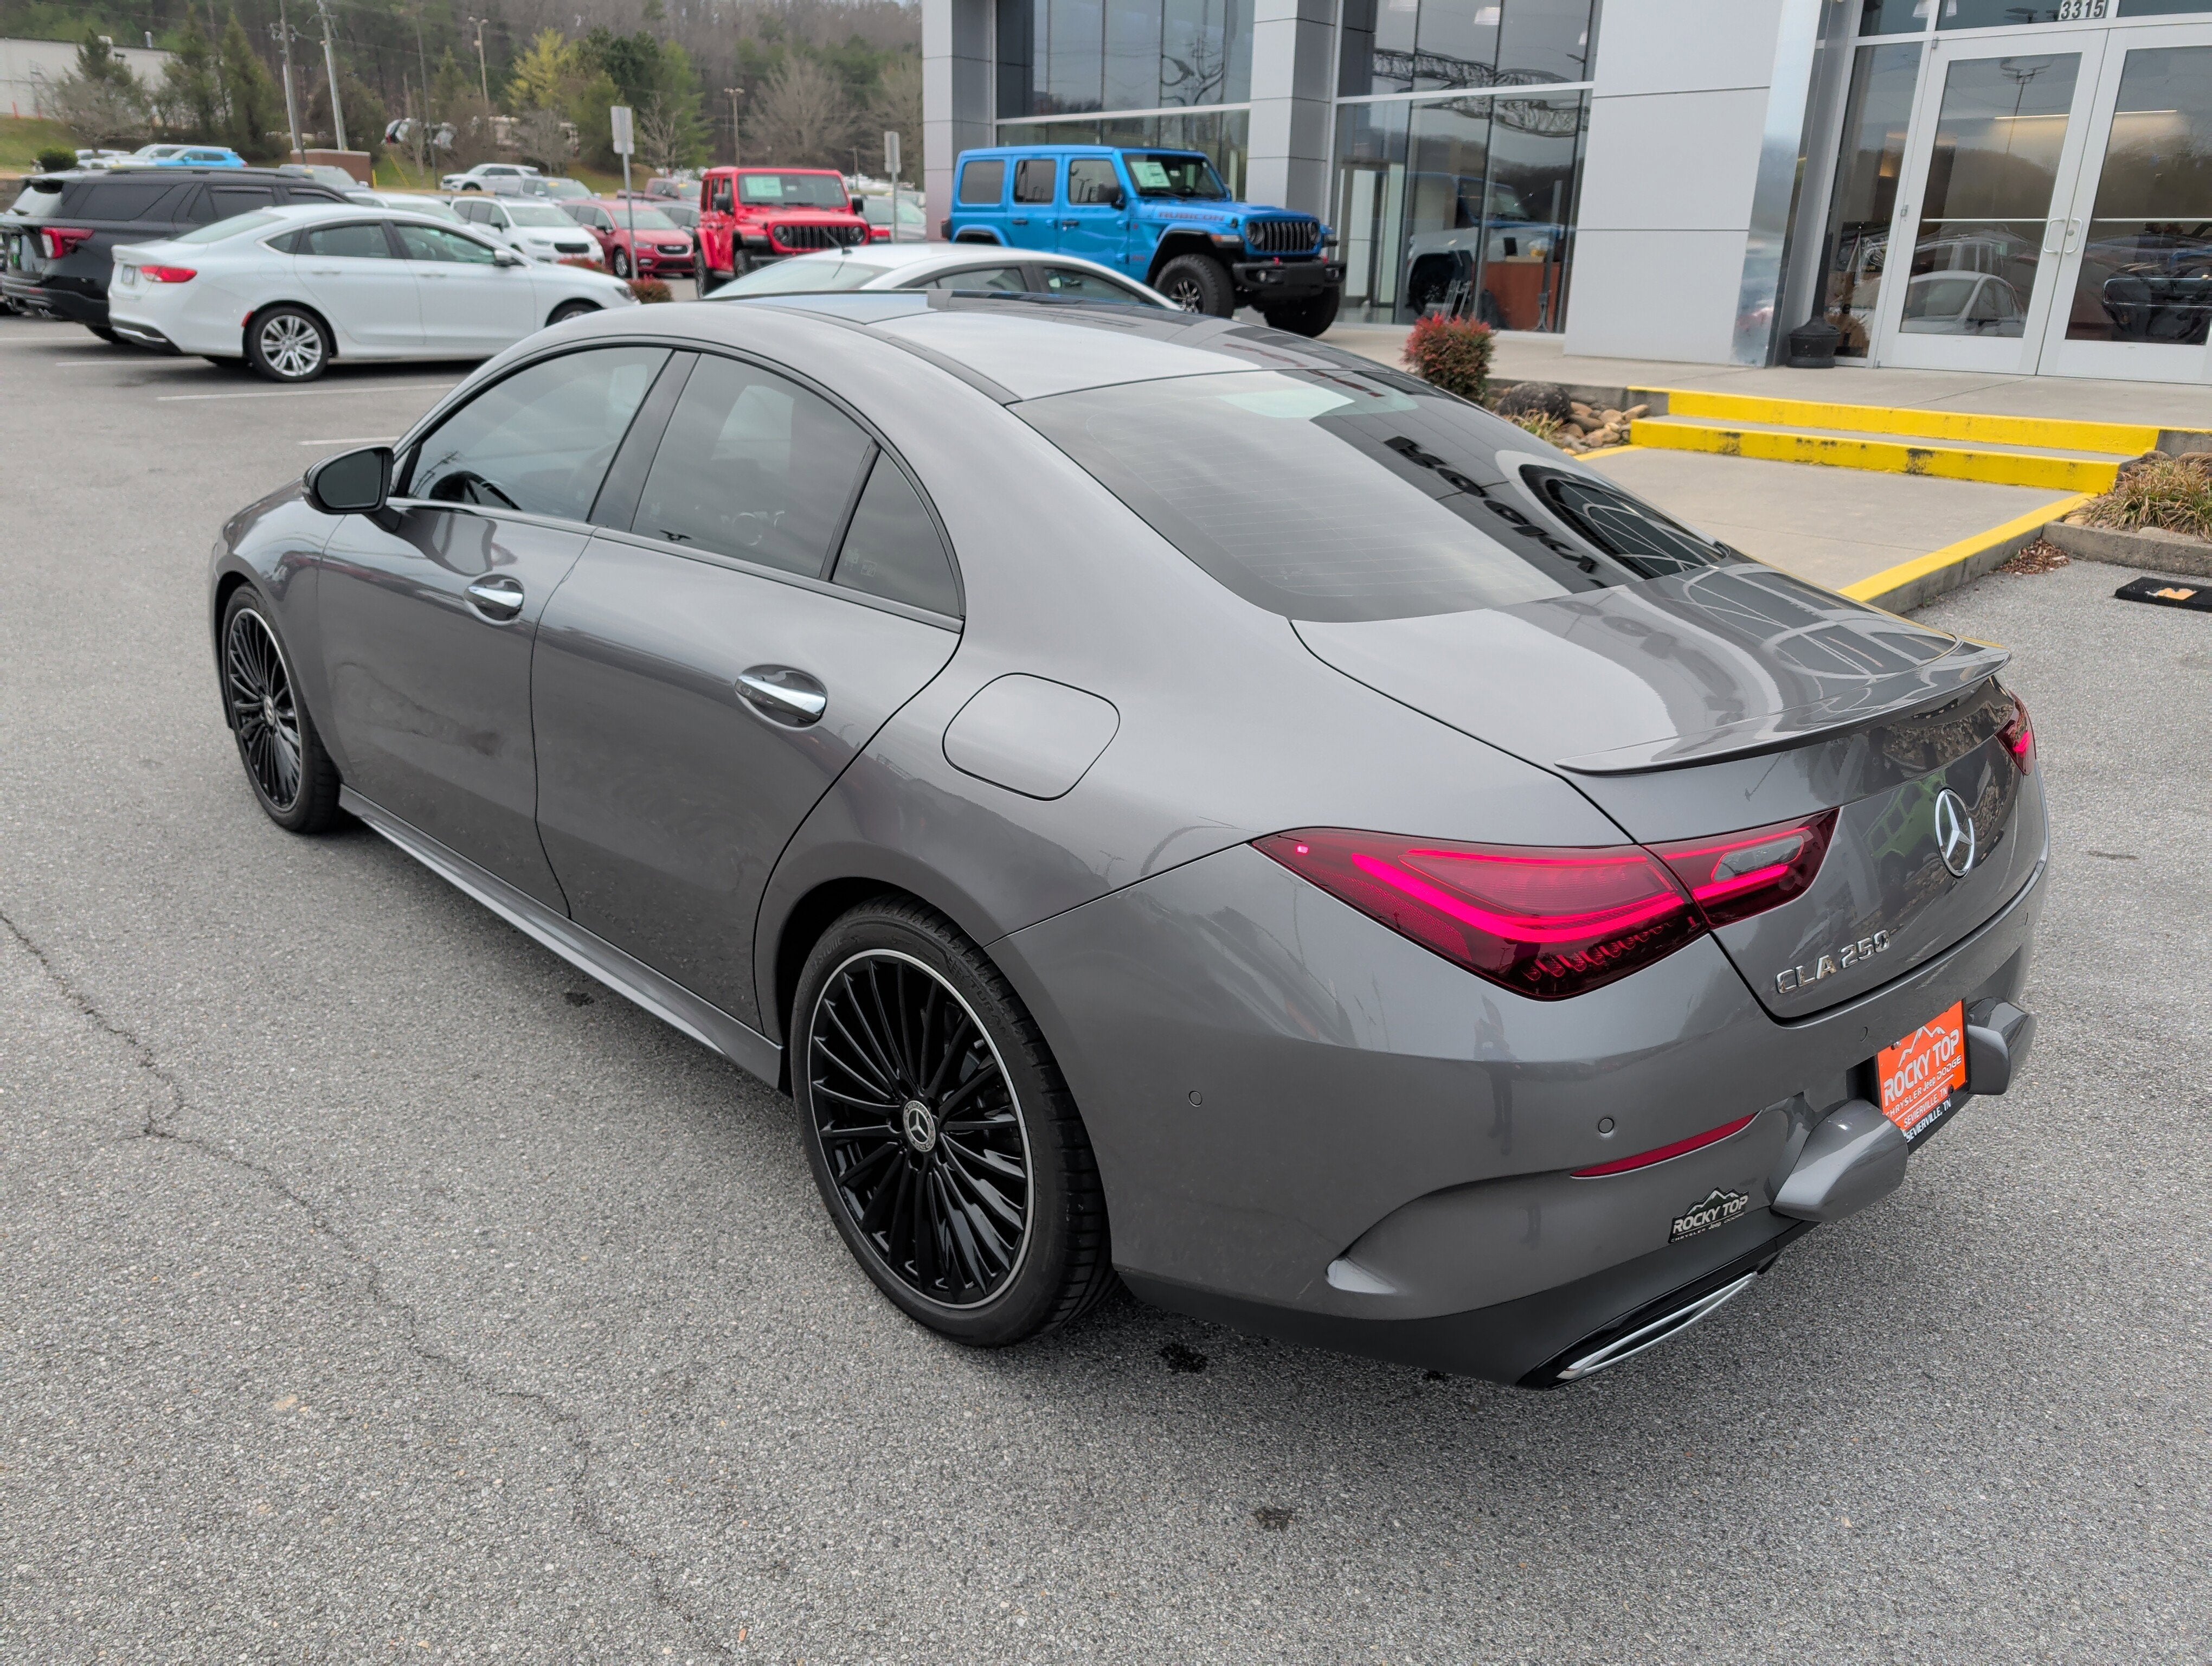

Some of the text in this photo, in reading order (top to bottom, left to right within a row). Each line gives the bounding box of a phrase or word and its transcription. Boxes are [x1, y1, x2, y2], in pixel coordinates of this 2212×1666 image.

[2061, 0, 2104, 19] 3315
[1776, 930, 1891, 994] CLA 250
[1883, 1029, 1960, 1107] ROCKY TOP
[1923, 1076, 1936, 1092] Jeep
[1937, 1054, 1962, 1080] DODGE
[1940, 1086, 1947, 1098] TN
[1943, 1098, 1951, 1111] TN
[1673, 1206, 1720, 1234] ROCKY
[1722, 1195, 1748, 1216] TOP
